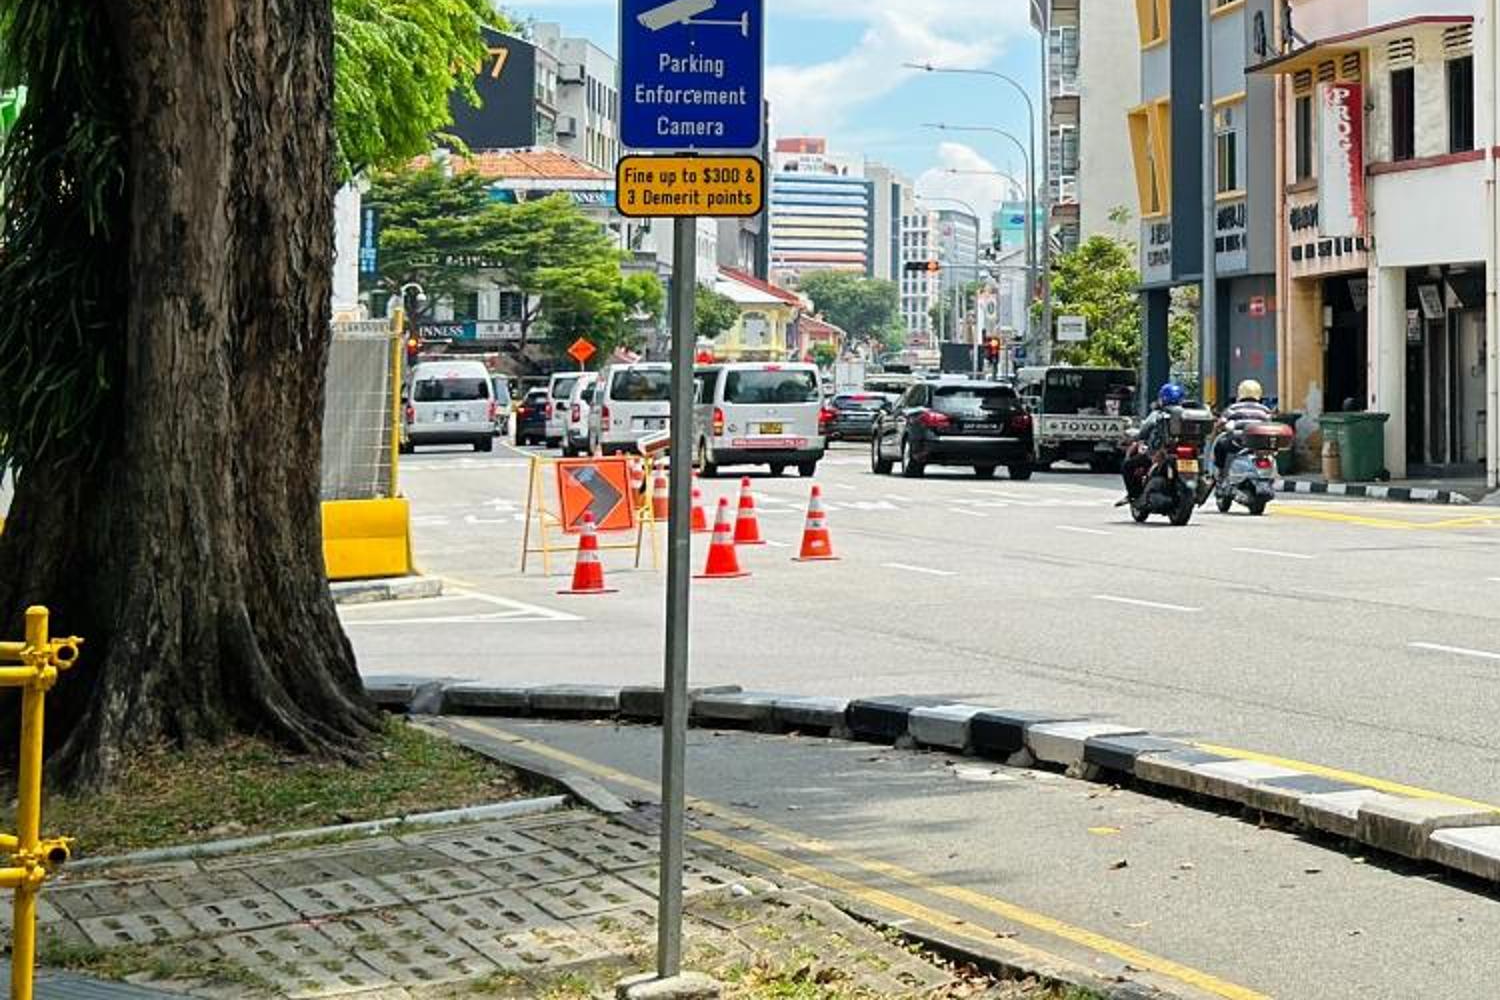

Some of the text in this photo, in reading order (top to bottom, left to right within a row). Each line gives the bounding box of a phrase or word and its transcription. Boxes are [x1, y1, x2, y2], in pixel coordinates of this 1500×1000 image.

[659, 53, 724, 78] Parking
[635, 84, 746, 105] Enforcement
[657, 116, 723, 136] Camera
[625, 167, 755, 187] Fine up to $300 &
[627, 189, 753, 208] 3 Demerit points
[419, 325, 464, 337] INNESS
[1060, 422, 1120, 432] TOYOTA
